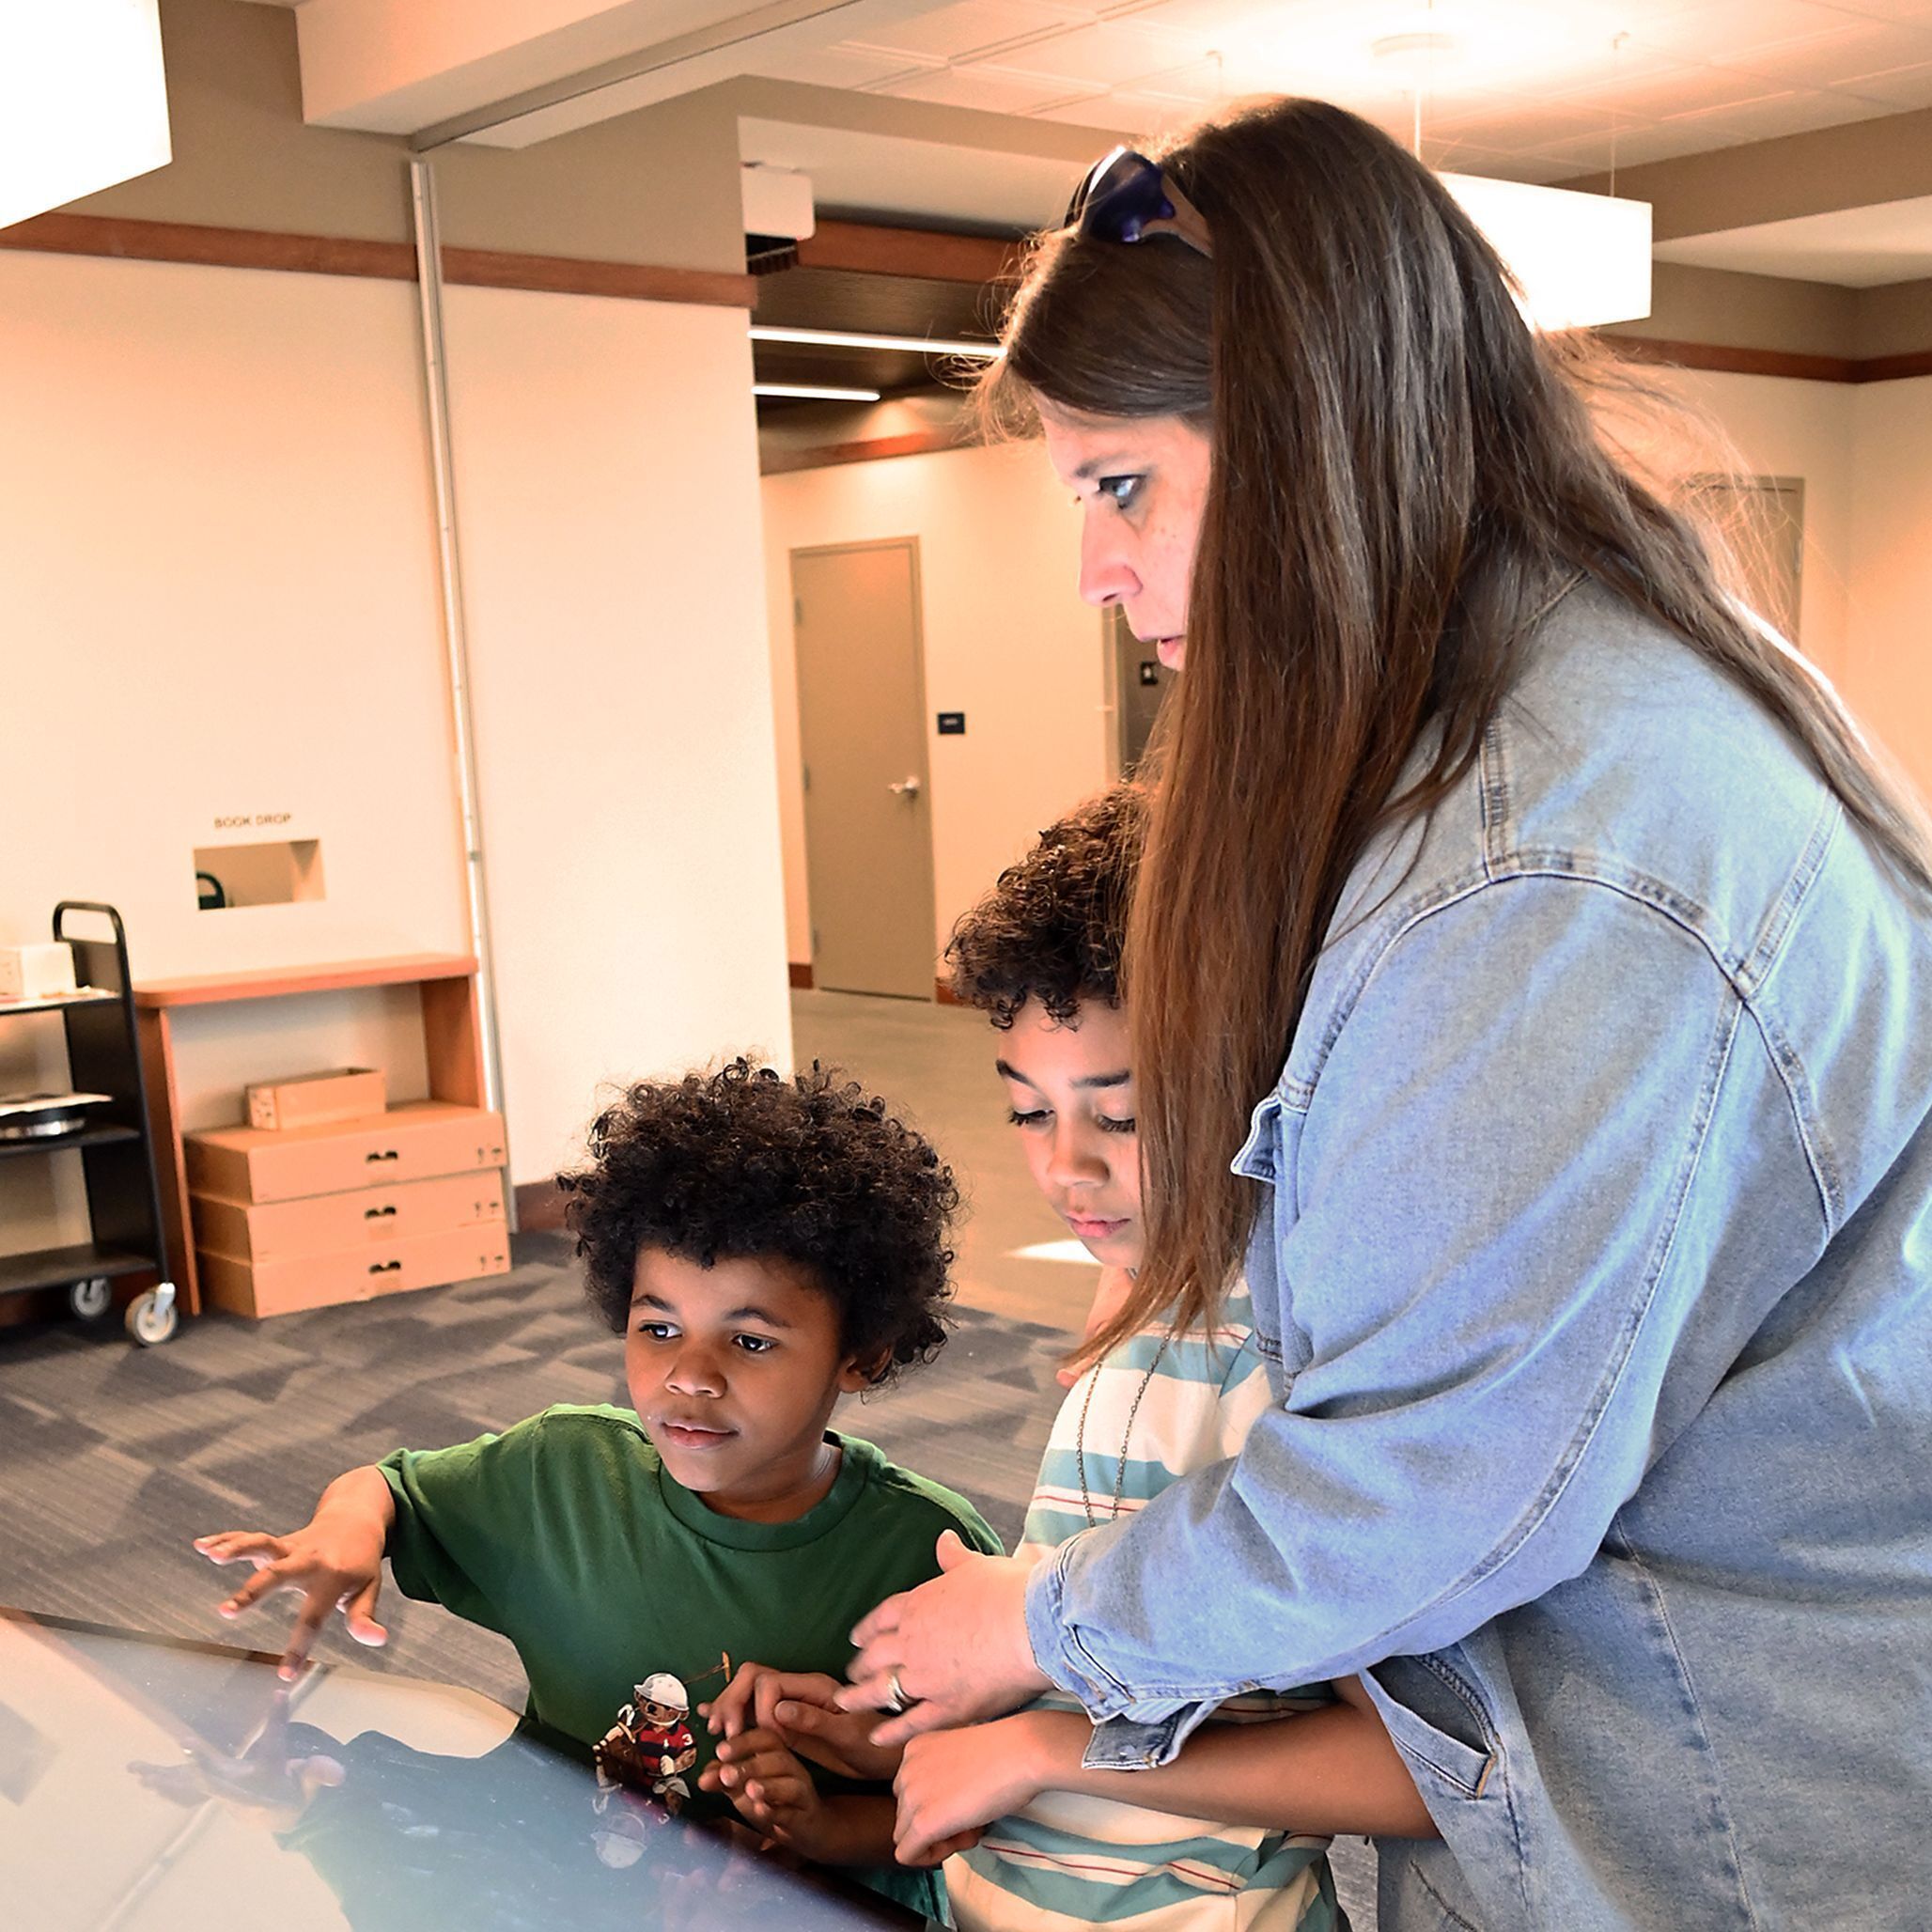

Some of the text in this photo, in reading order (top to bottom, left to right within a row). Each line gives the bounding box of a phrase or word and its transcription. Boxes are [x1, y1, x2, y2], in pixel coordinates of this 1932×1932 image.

[214, 812, 291, 829] BOOK DROP
[682, 1733, 693, 1746] 3
